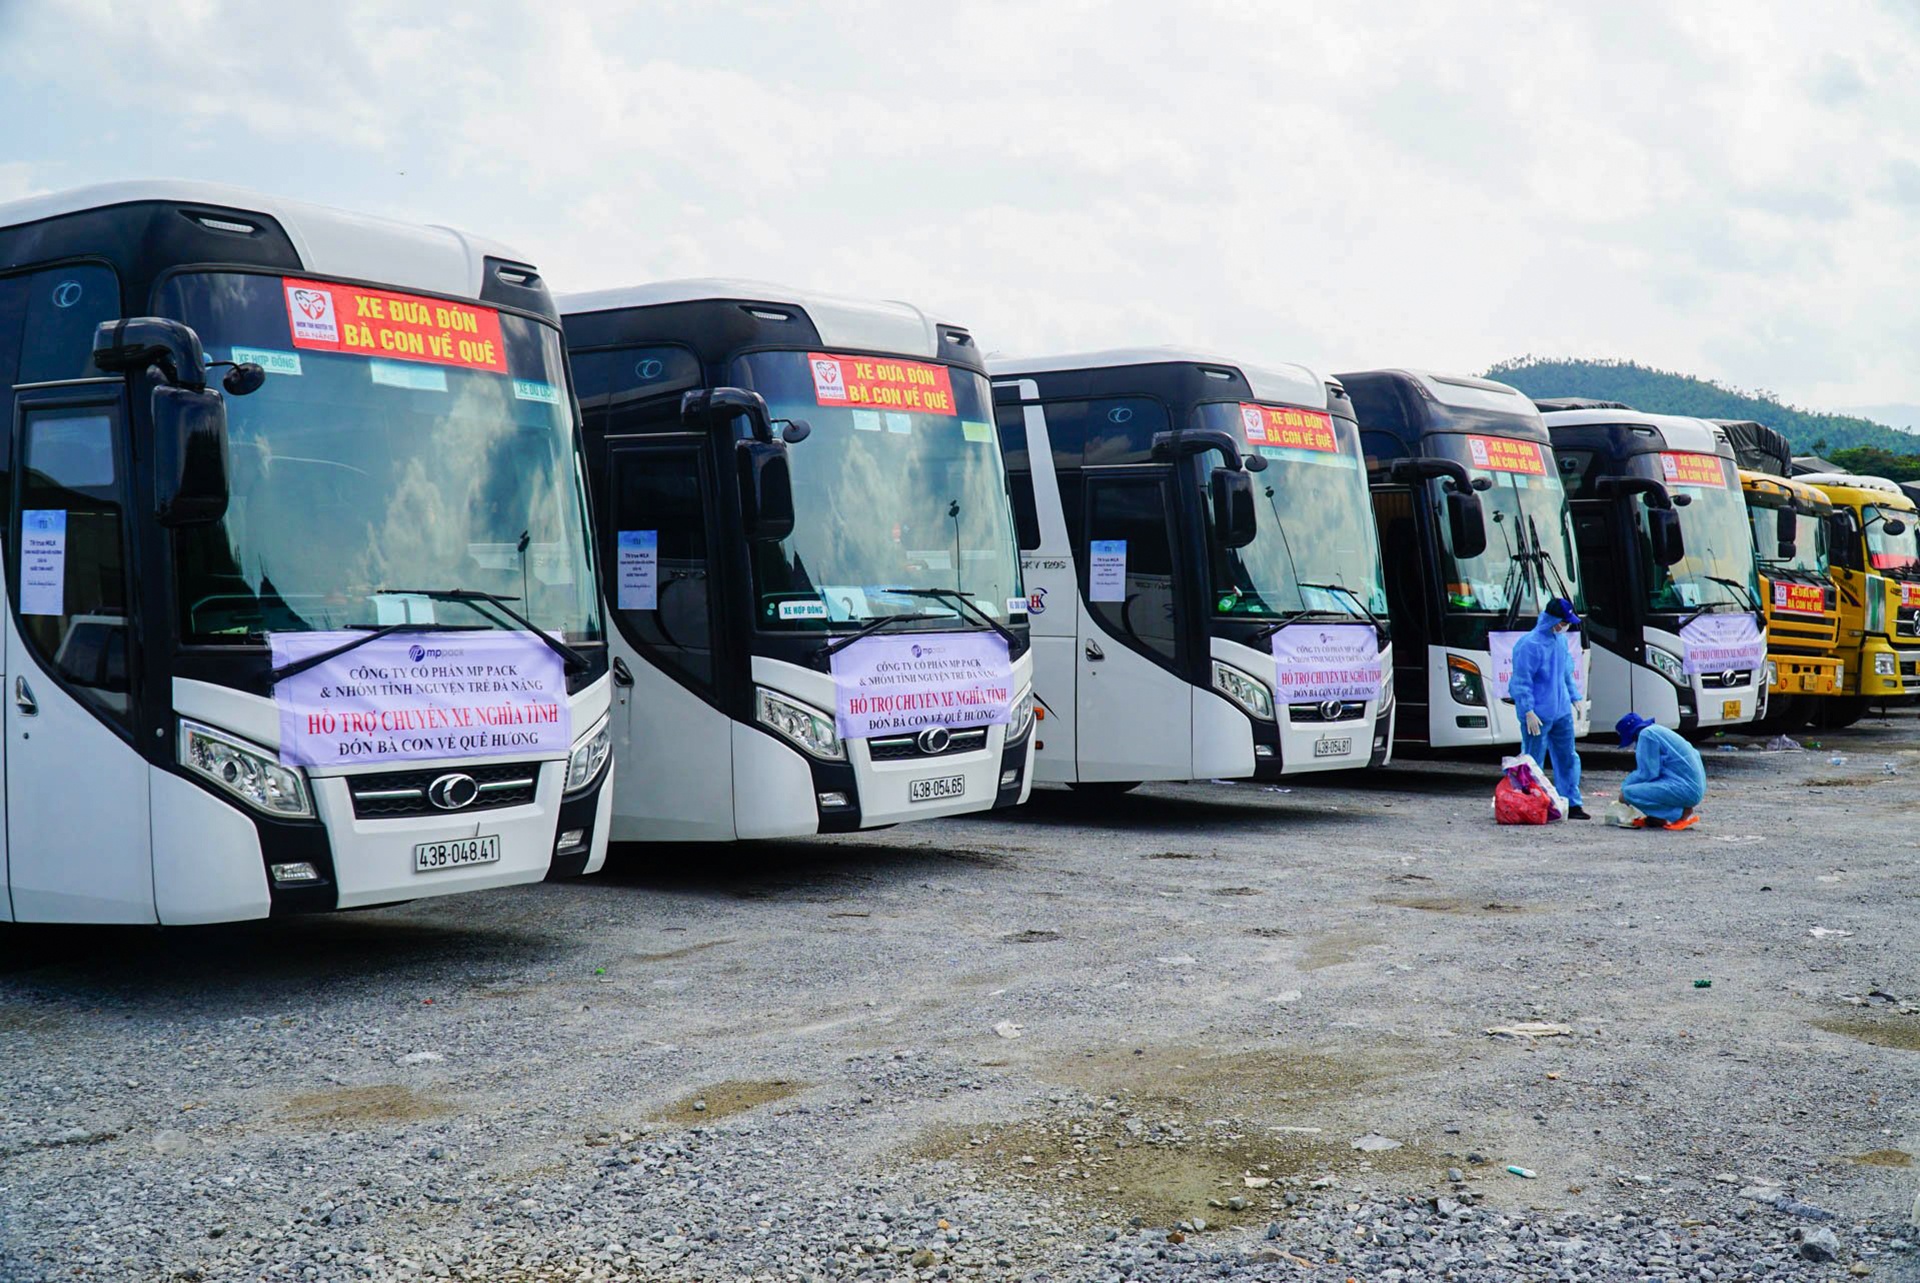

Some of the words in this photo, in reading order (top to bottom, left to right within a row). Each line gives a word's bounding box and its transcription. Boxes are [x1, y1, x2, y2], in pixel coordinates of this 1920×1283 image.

[355, 296, 384, 319] XE
[389, 300, 432, 326] ĐƯA
[436, 306, 478, 333] ĐÓN
[344, 322, 375, 348] BÀ
[380, 329, 424, 354] CON
[428, 331, 454, 358] VỀ
[459, 340, 496, 364] QUÊ
[855, 363, 874, 380] XE
[877, 364, 905, 382] ĐƯA
[908, 367, 936, 386] ĐÓN
[849, 382, 870, 402] BÀ
[872, 388, 902, 405] CON
[904, 386, 922, 408] VỀ
[924, 390, 949, 410] QUÊ
[1270, 411, 1284, 425] XE
[1284, 412, 1303, 427] ĐƯA
[1305, 414, 1323, 429] ĐÓN
[1267, 427, 1281, 442] BÀ
[1282, 430, 1302, 444] CON
[1303, 430, 1315, 445] VỀ
[1316, 432, 1332, 448] QUÊ
[784, 606, 792, 614] XE
[794, 605, 806, 614] HỢP
[807, 604, 823, 614] ĐỒNG
[350, 665, 388, 680] CÔNG
[391, 668, 407, 678] TY
[411, 664, 429, 678] CỔ
[432, 664, 463, 678] PHẦN
[467, 666, 484, 677] MP
[487, 664, 518, 676] PACK
[320, 686, 331, 698] &
[336, 682, 377, 697] NHÓM
[380, 682, 412, 695] TÌNH
[415, 682, 465, 696] NGUYỆN
[468, 679, 491, 692] TRẺ
[493, 678, 508, 692] ĐÀ
[512, 678, 543, 691] NẴNG
[850, 692, 867, 714] HỖ
[870, 694, 893, 715] TRỢ
[896, 689, 939, 711] CHUYẾN
[941, 691, 954, 707] XE
[956, 686, 986, 705] NGHĨA
[986, 684, 1007, 704] TÌNH
[308, 705, 335, 734] HỖ
[339, 710, 377, 737] TRỢ
[381, 702, 449, 731] CHUYẾN
[452, 707, 473, 728] XE
[475, 701, 523, 725] NGHĨA
[524, 698, 558, 724] TÌNH
[339, 738, 372, 756] ĐÓN
[377, 736, 397, 753] BÀ
[402, 738, 433, 752] CON
[438, 733, 456, 749] VỀ
[460, 731, 488, 750] QUÊ
[492, 731, 538, 747] HƯƠNG
[913, 778, 962, 798] 43B-054.65
[420, 839, 494, 867] 43B-048.41
